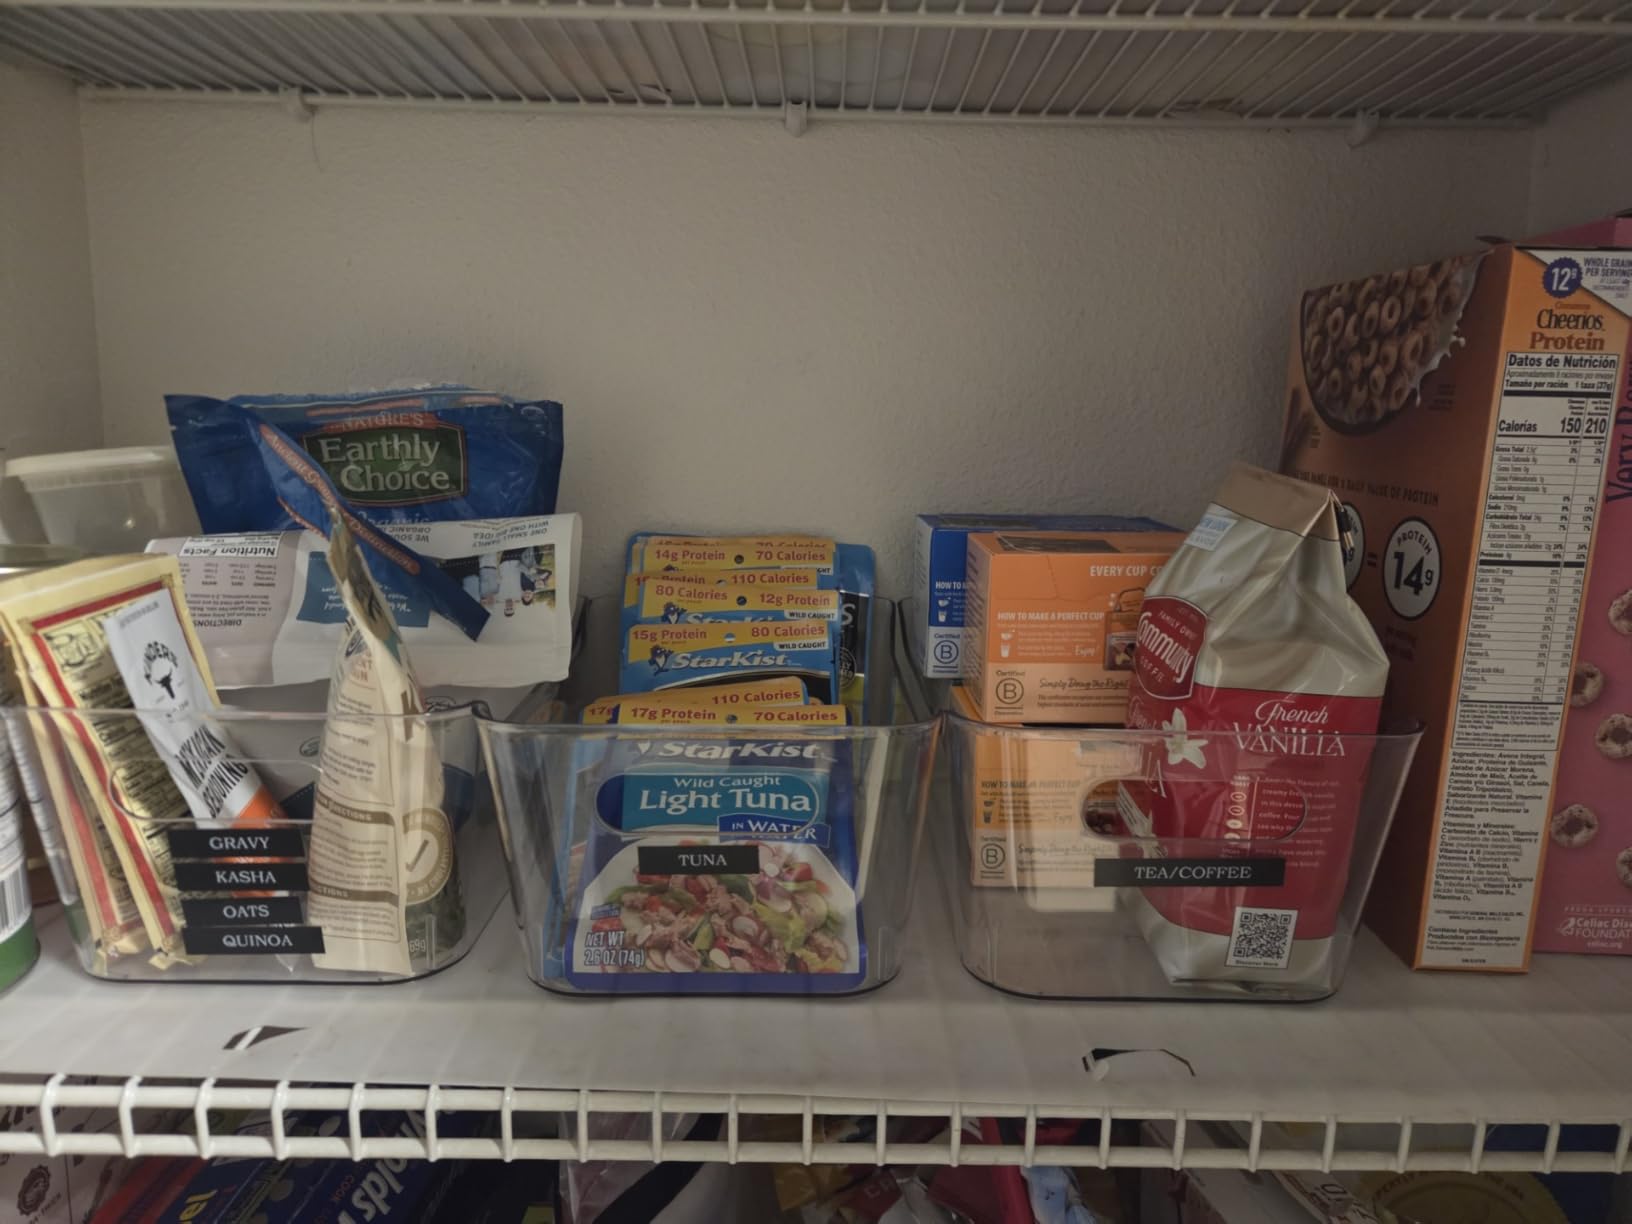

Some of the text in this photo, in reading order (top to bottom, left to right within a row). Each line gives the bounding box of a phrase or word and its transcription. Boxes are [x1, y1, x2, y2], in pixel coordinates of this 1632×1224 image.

[1537, 309, 1603, 330] Cheerios
[1529, 331, 1605, 351] Protein
[1509, 354, 1616, 369] Datos de Nutrición
[1505, 379, 1568, 389] Tamaño por ración
[1498, 417, 1607, 434] Calorías 150 210
[320, 434, 440, 467] Earthly
[340, 462, 451, 492] Choice
[1391, 486, 1400, 499] OF
[1403, 487, 1439, 506] PROTEIN
[1397, 530, 1433, 556] PROTEIN
[183, 546, 276, 556] Nutrition Facts
[656, 550, 725, 561] 14g Protein
[756, 550, 826, 561] 70 Calories
[731, 573, 809, 584] 110 Calories
[1090, 565, 1147, 577] EVERY CUP
[655, 585, 728, 601] 80 Calories
[935, 581, 962, 590] HOW TO
[759, 593, 831, 606] 12g Protein
[998, 611, 1016, 621] HOW
[1017, 611, 1027, 621] TO
[1028, 611, 1049, 621] MAKE
[1057, 611, 1089, 621] PERFECT
[1088, 611, 1105, 621] CUP
[632, 629, 708, 642] 15g Protein
[751, 624, 825, 638] 80 Calories
[671, 649, 788, 669] StarKist
[712, 688, 801, 705] 110 Calories
[631, 707, 717, 721] 17g Protein
[753, 710, 838, 722] 70 Calories
[1255, 698, 1329, 727] French
[1233, 721, 1346, 757] VANILLA
[174, 724, 226, 790] MEXICAN
[658, 741, 820, 760] StarKist
[673, 775, 781, 789] Wild Caught
[639, 788, 812, 816] Light Tuna
[731, 819, 818, 840] IN WATER
[208, 836, 271, 850] GRAVY
[678, 853, 728, 866] TUNA
[215, 869, 277, 885] KASHA
[1134, 865, 1253, 880] TEA/COFFEE
[222, 904, 271, 919] OATS
[222, 934, 294, 948] QUINOA
[584, 931, 625, 948] NET WT
[584, 949, 645, 968] 2.6 OZ (74g)
